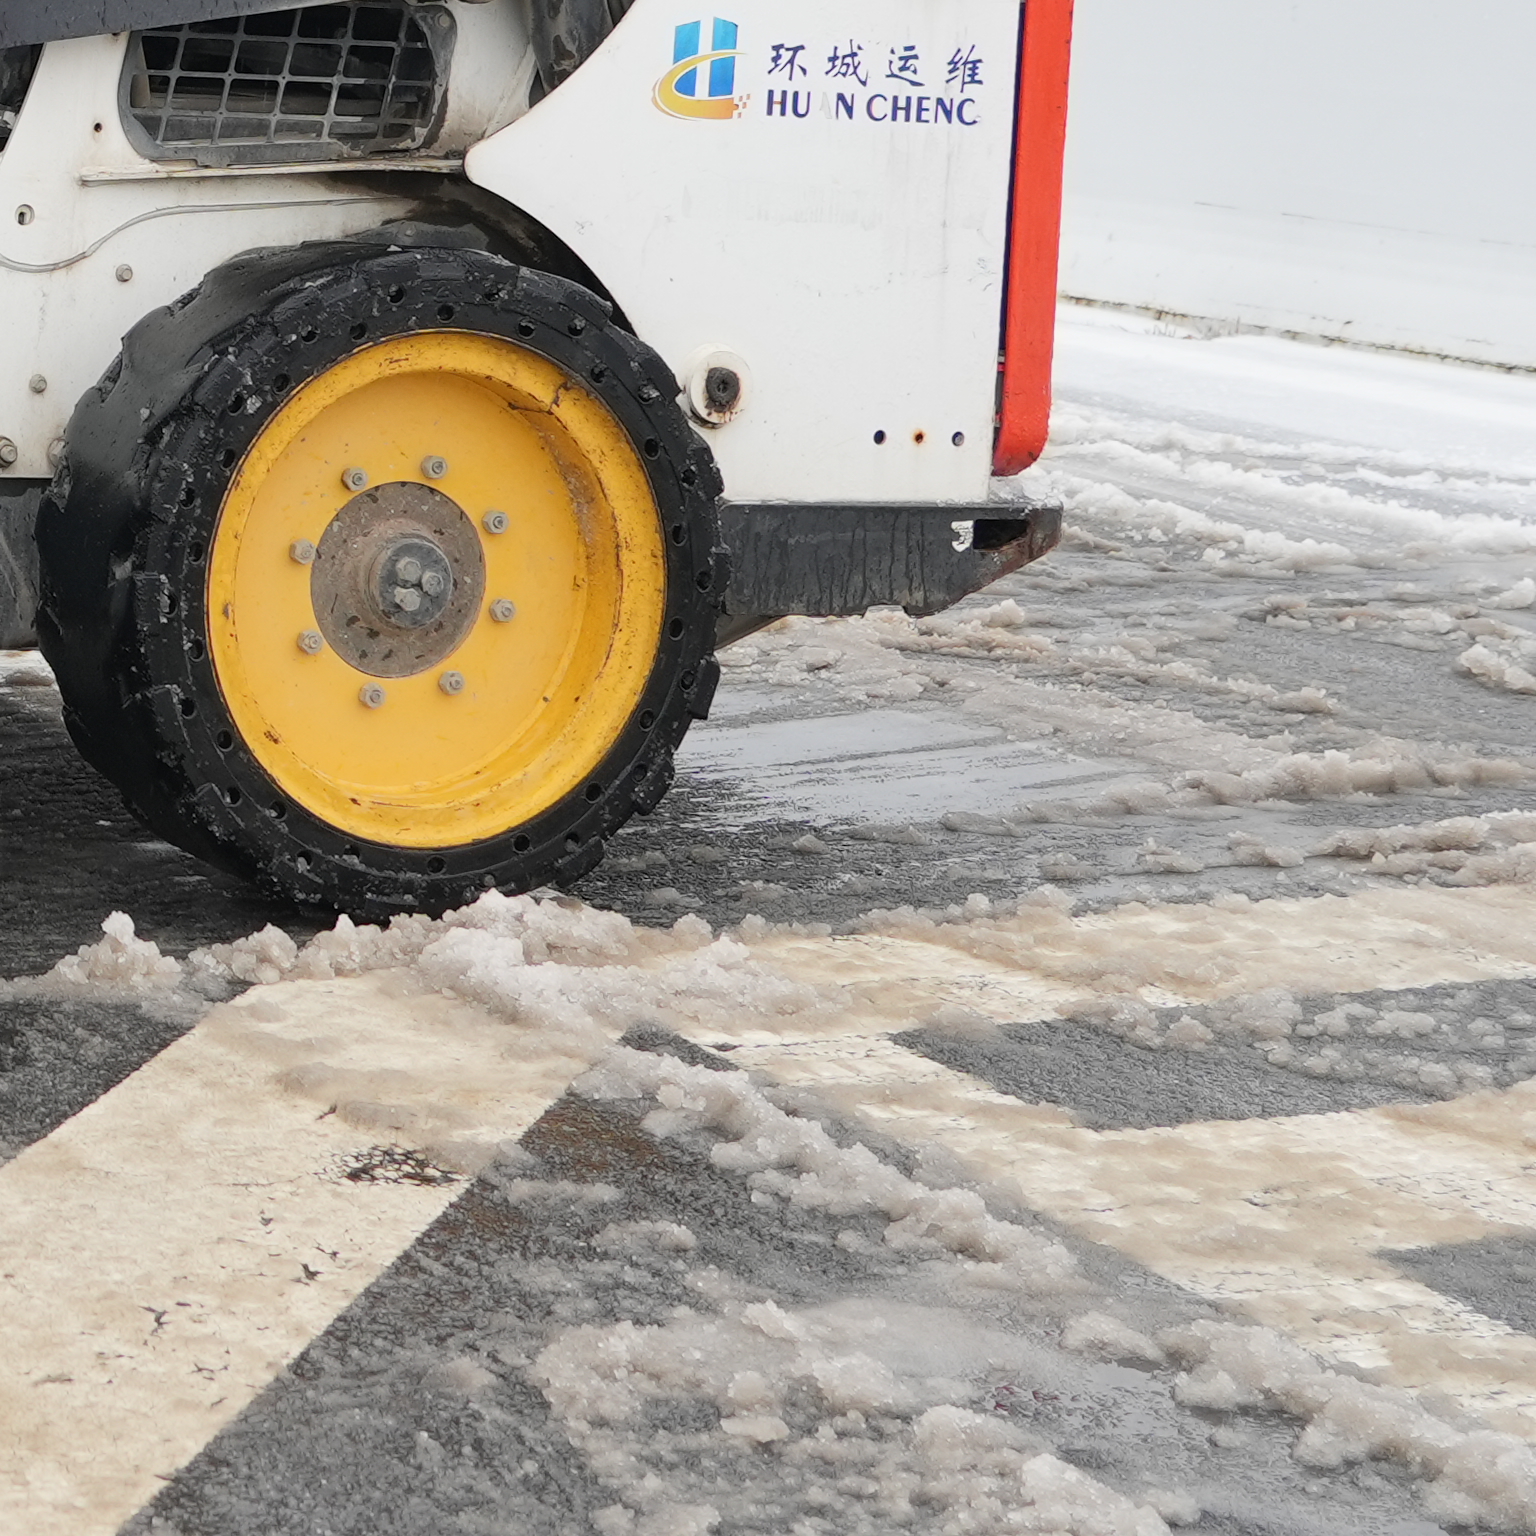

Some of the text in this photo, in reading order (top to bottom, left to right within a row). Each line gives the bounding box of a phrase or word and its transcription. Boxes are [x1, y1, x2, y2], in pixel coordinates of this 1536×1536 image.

[767, 39, 984, 93] 环城运维
[766, 89, 855, 120] HUN
